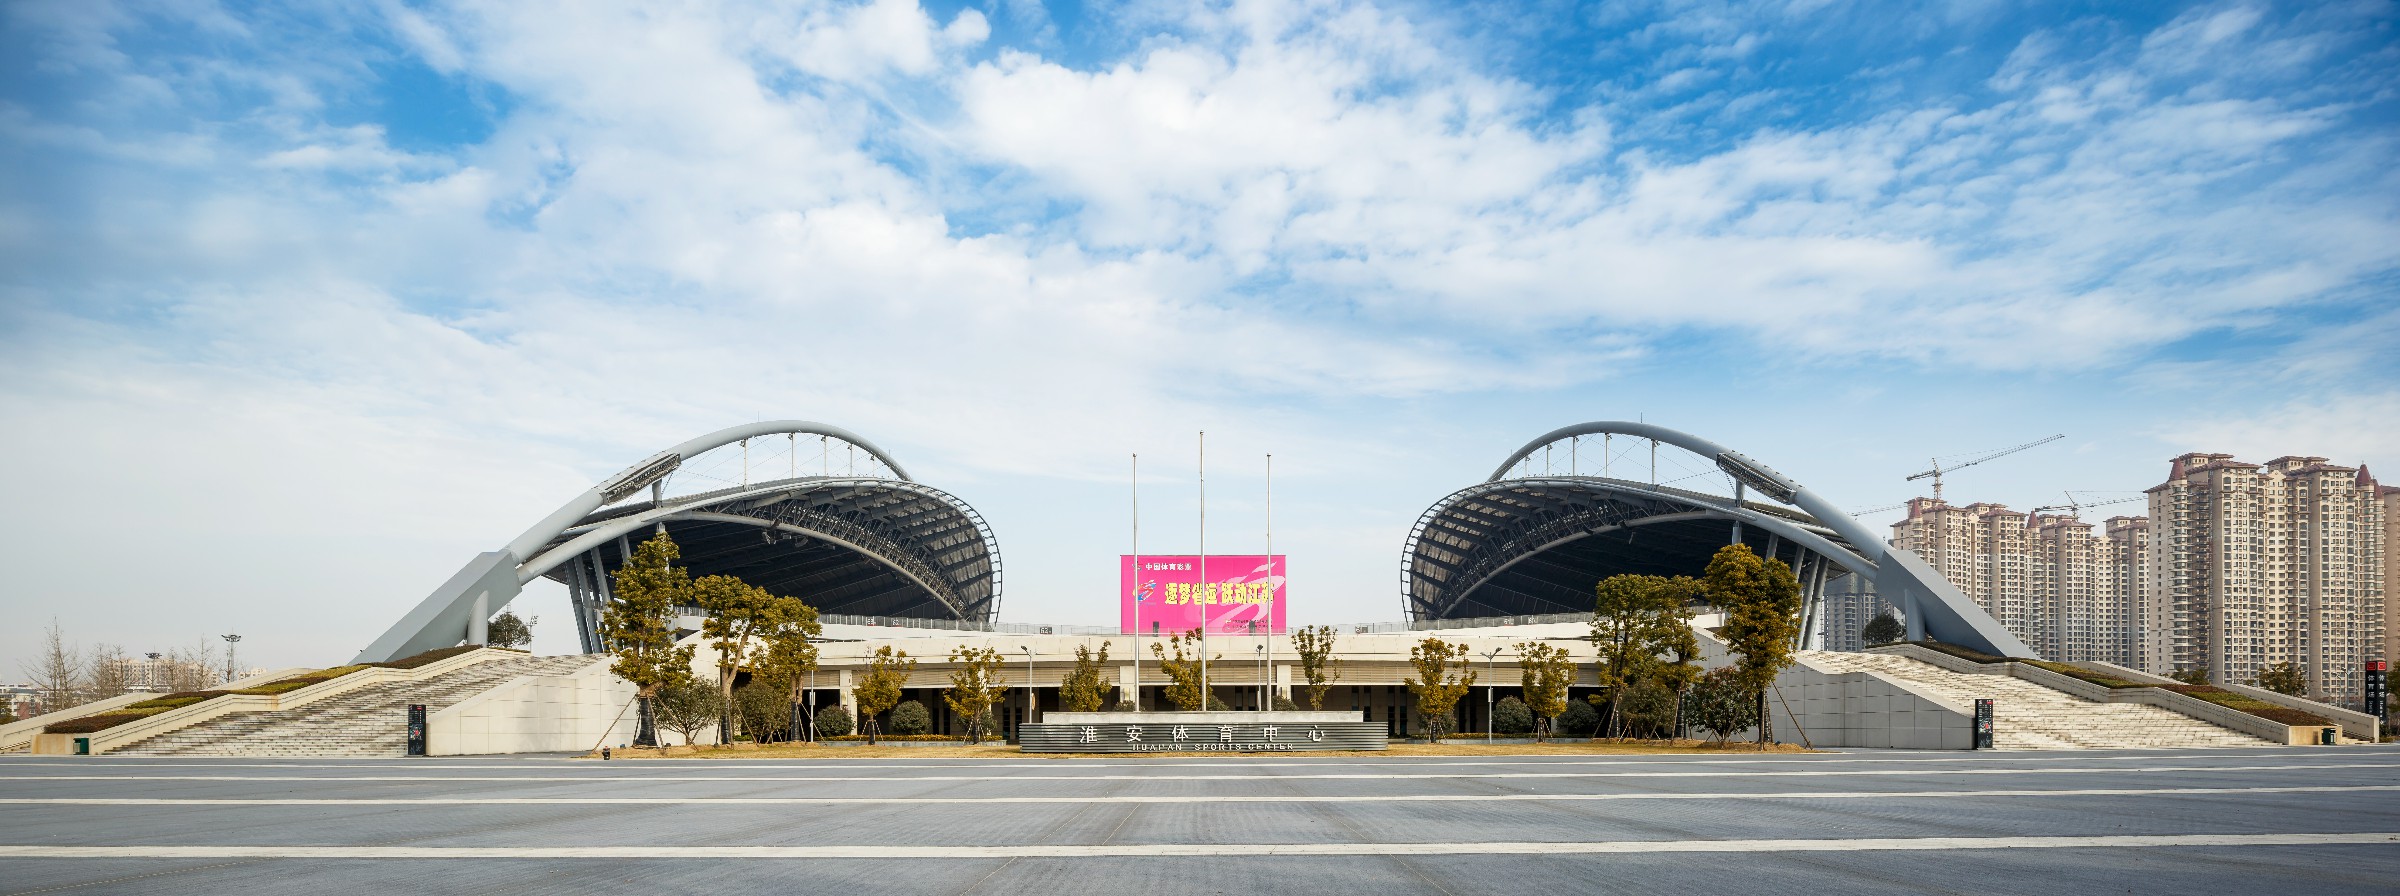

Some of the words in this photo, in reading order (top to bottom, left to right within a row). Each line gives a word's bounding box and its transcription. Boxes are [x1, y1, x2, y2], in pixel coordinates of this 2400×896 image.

[1146, 563, 1192, 571] 中国体育彩票
[1080, 725, 1325, 743] 淮安体育中心
[1195, 743, 1242, 751] SPORTS
[1248, 742, 1294, 750] CENTER
